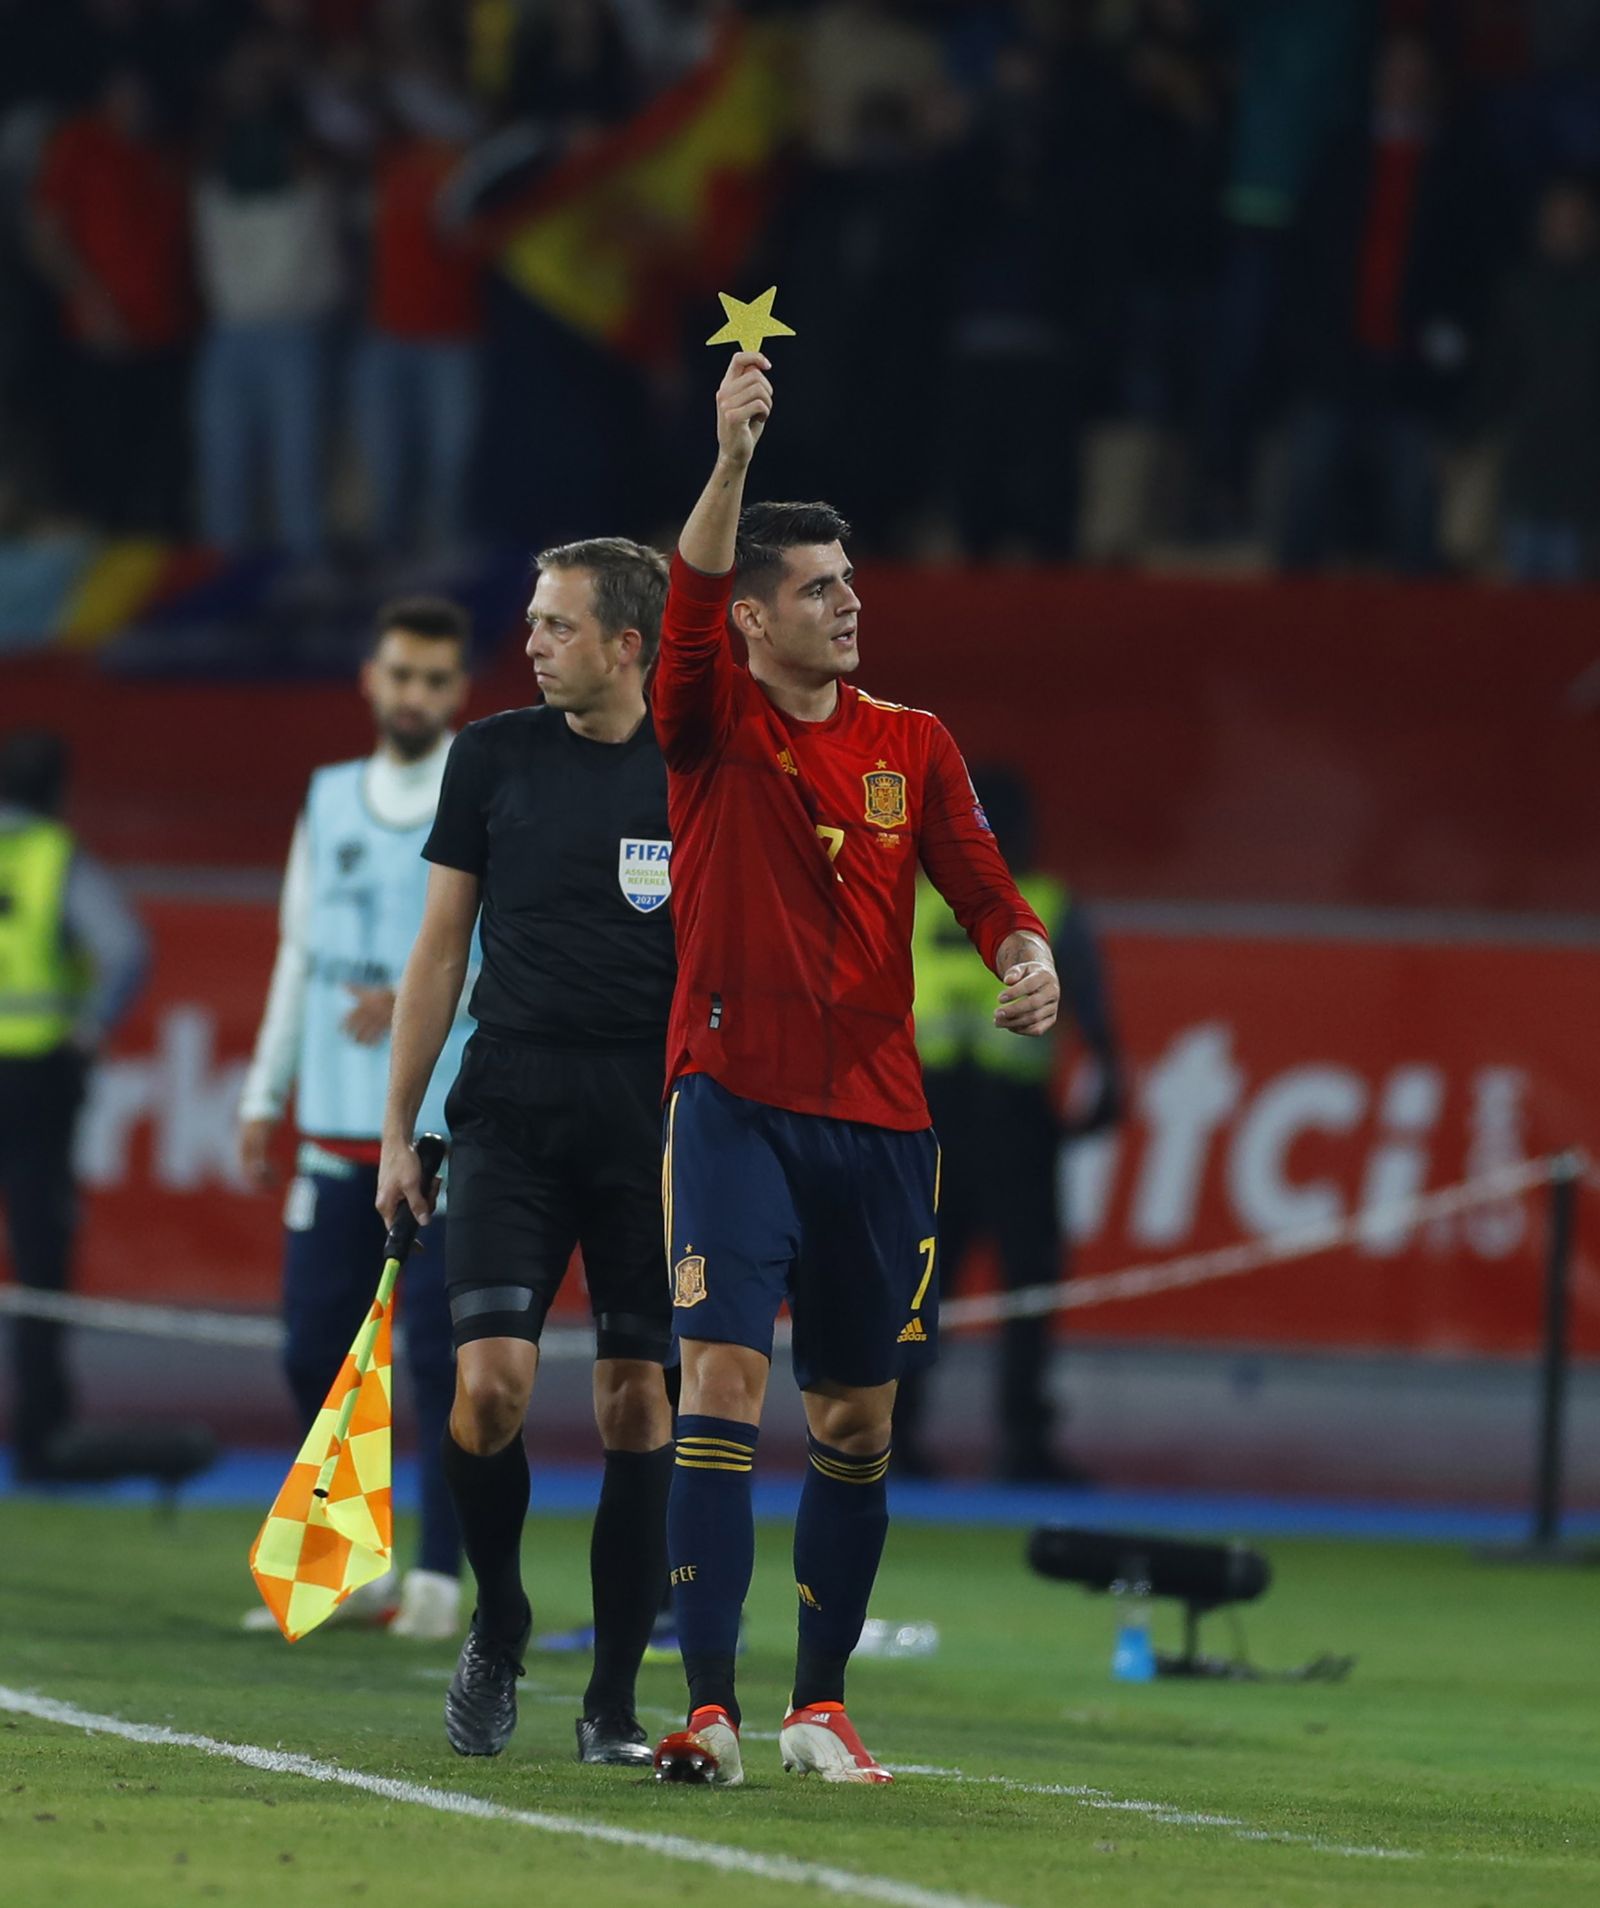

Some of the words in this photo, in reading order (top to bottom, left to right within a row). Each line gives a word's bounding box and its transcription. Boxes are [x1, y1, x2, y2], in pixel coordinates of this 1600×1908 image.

[625, 843, 671, 861] FIFA
[624, 868, 668, 877] ASSISTAN
[635, 895, 657, 905] 2021
[910, 1236, 936, 1310] 7
